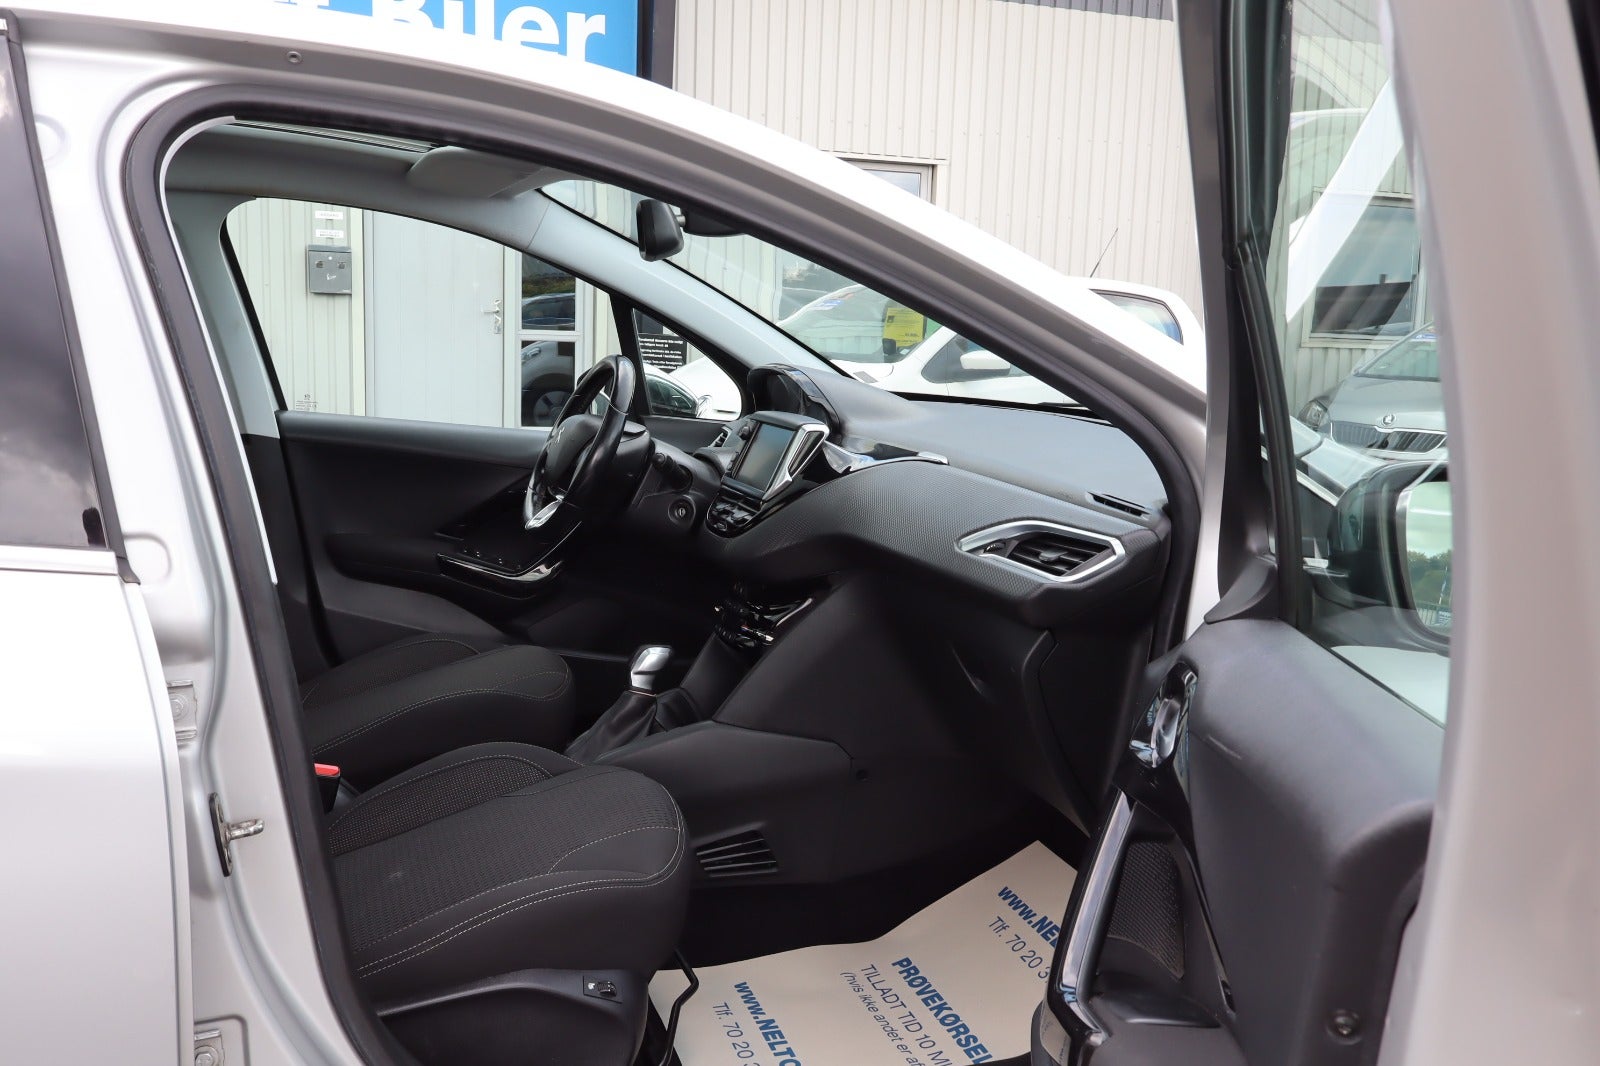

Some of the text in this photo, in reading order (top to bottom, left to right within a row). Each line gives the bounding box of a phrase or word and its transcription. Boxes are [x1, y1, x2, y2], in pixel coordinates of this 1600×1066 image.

[989, 916, 1010, 938] Tlf.
[1005, 934, 1026, 952] 70
[1020, 950, 1043, 968] 20
[712, 1002, 733, 1020] Tlf.
[858, 994, 879, 1012] ikke
[873, 1014, 904, 1042] andet
[896, 1043, 912, 1054] er
[861, 964, 907, 1010] TILLADT
[898, 1011, 923, 1033] TID
[915, 1034, 936, 1049] 10
[722, 1021, 743, 1038] 70
[732, 1041, 754, 1059] 20
